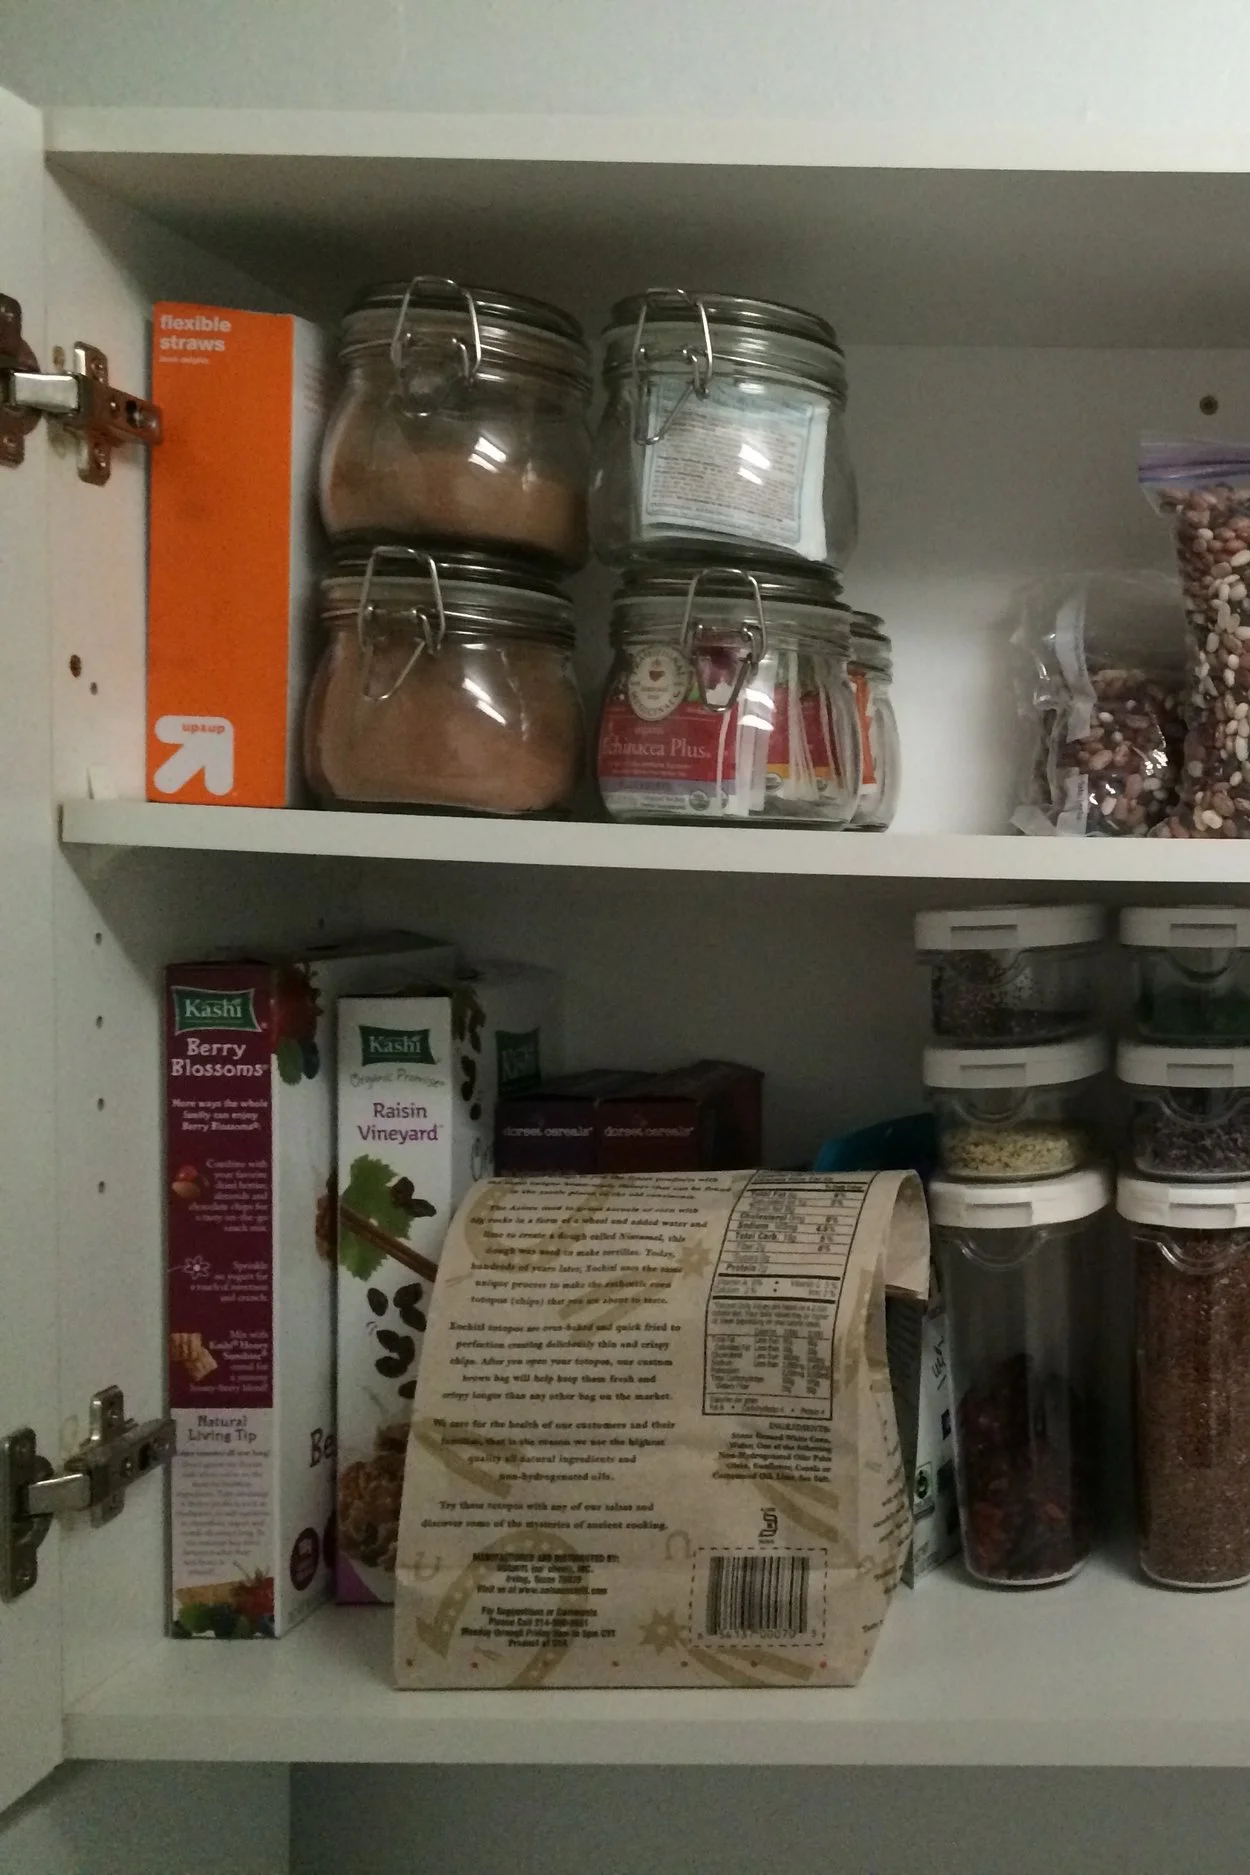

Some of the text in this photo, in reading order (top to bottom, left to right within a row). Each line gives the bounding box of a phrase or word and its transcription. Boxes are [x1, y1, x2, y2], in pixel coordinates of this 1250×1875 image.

[160, 315, 231, 332] flexible
[160, 335, 224, 351] straws
[185, 997, 242, 1018] Kashi
[187, 1038, 246, 1059] Berry
[369, 1036, 421, 1053] Kashi
[172, 1059, 264, 1077] Blossoms
[172, 1099, 268, 1110] More ways the whole
[373, 1102, 427, 1118] Raisin
[183, 1111, 258, 1121] family can enjoy
[182, 1122, 208, 1132] Berry
[604, 1126, 643, 1137] dorset
[358, 1124, 438, 1144] Vineyard
[736, 1232, 755, 1240] Total
[725, 1264, 756, 1272] Protein
[456, 1341, 504, 1349] perfection
[546, 1340, 594, 1349] deliciously
[598, 1340, 617, 1348] thin
[641, 1340, 669, 1351] crispy
[442, 1392, 469, 1401] crispy
[473, 1392, 501, 1401] longer
[505, 1392, 526, 1400] than
[530, 1393, 546, 1401] any
[549, 1392, 574, 1400] other
[578, 1392, 596, 1401] bag
[616, 1392, 631, 1400] the
[635, 1392, 673, 1400] market.
[197, 1415, 248, 1427] Natural
[188, 1428, 257, 1443] Living Tip
[468, 1454, 636, 1464] quality all natural ingredients and
[421, 1519, 668, 1530] discover some of the mysteries of ancient cooking.
